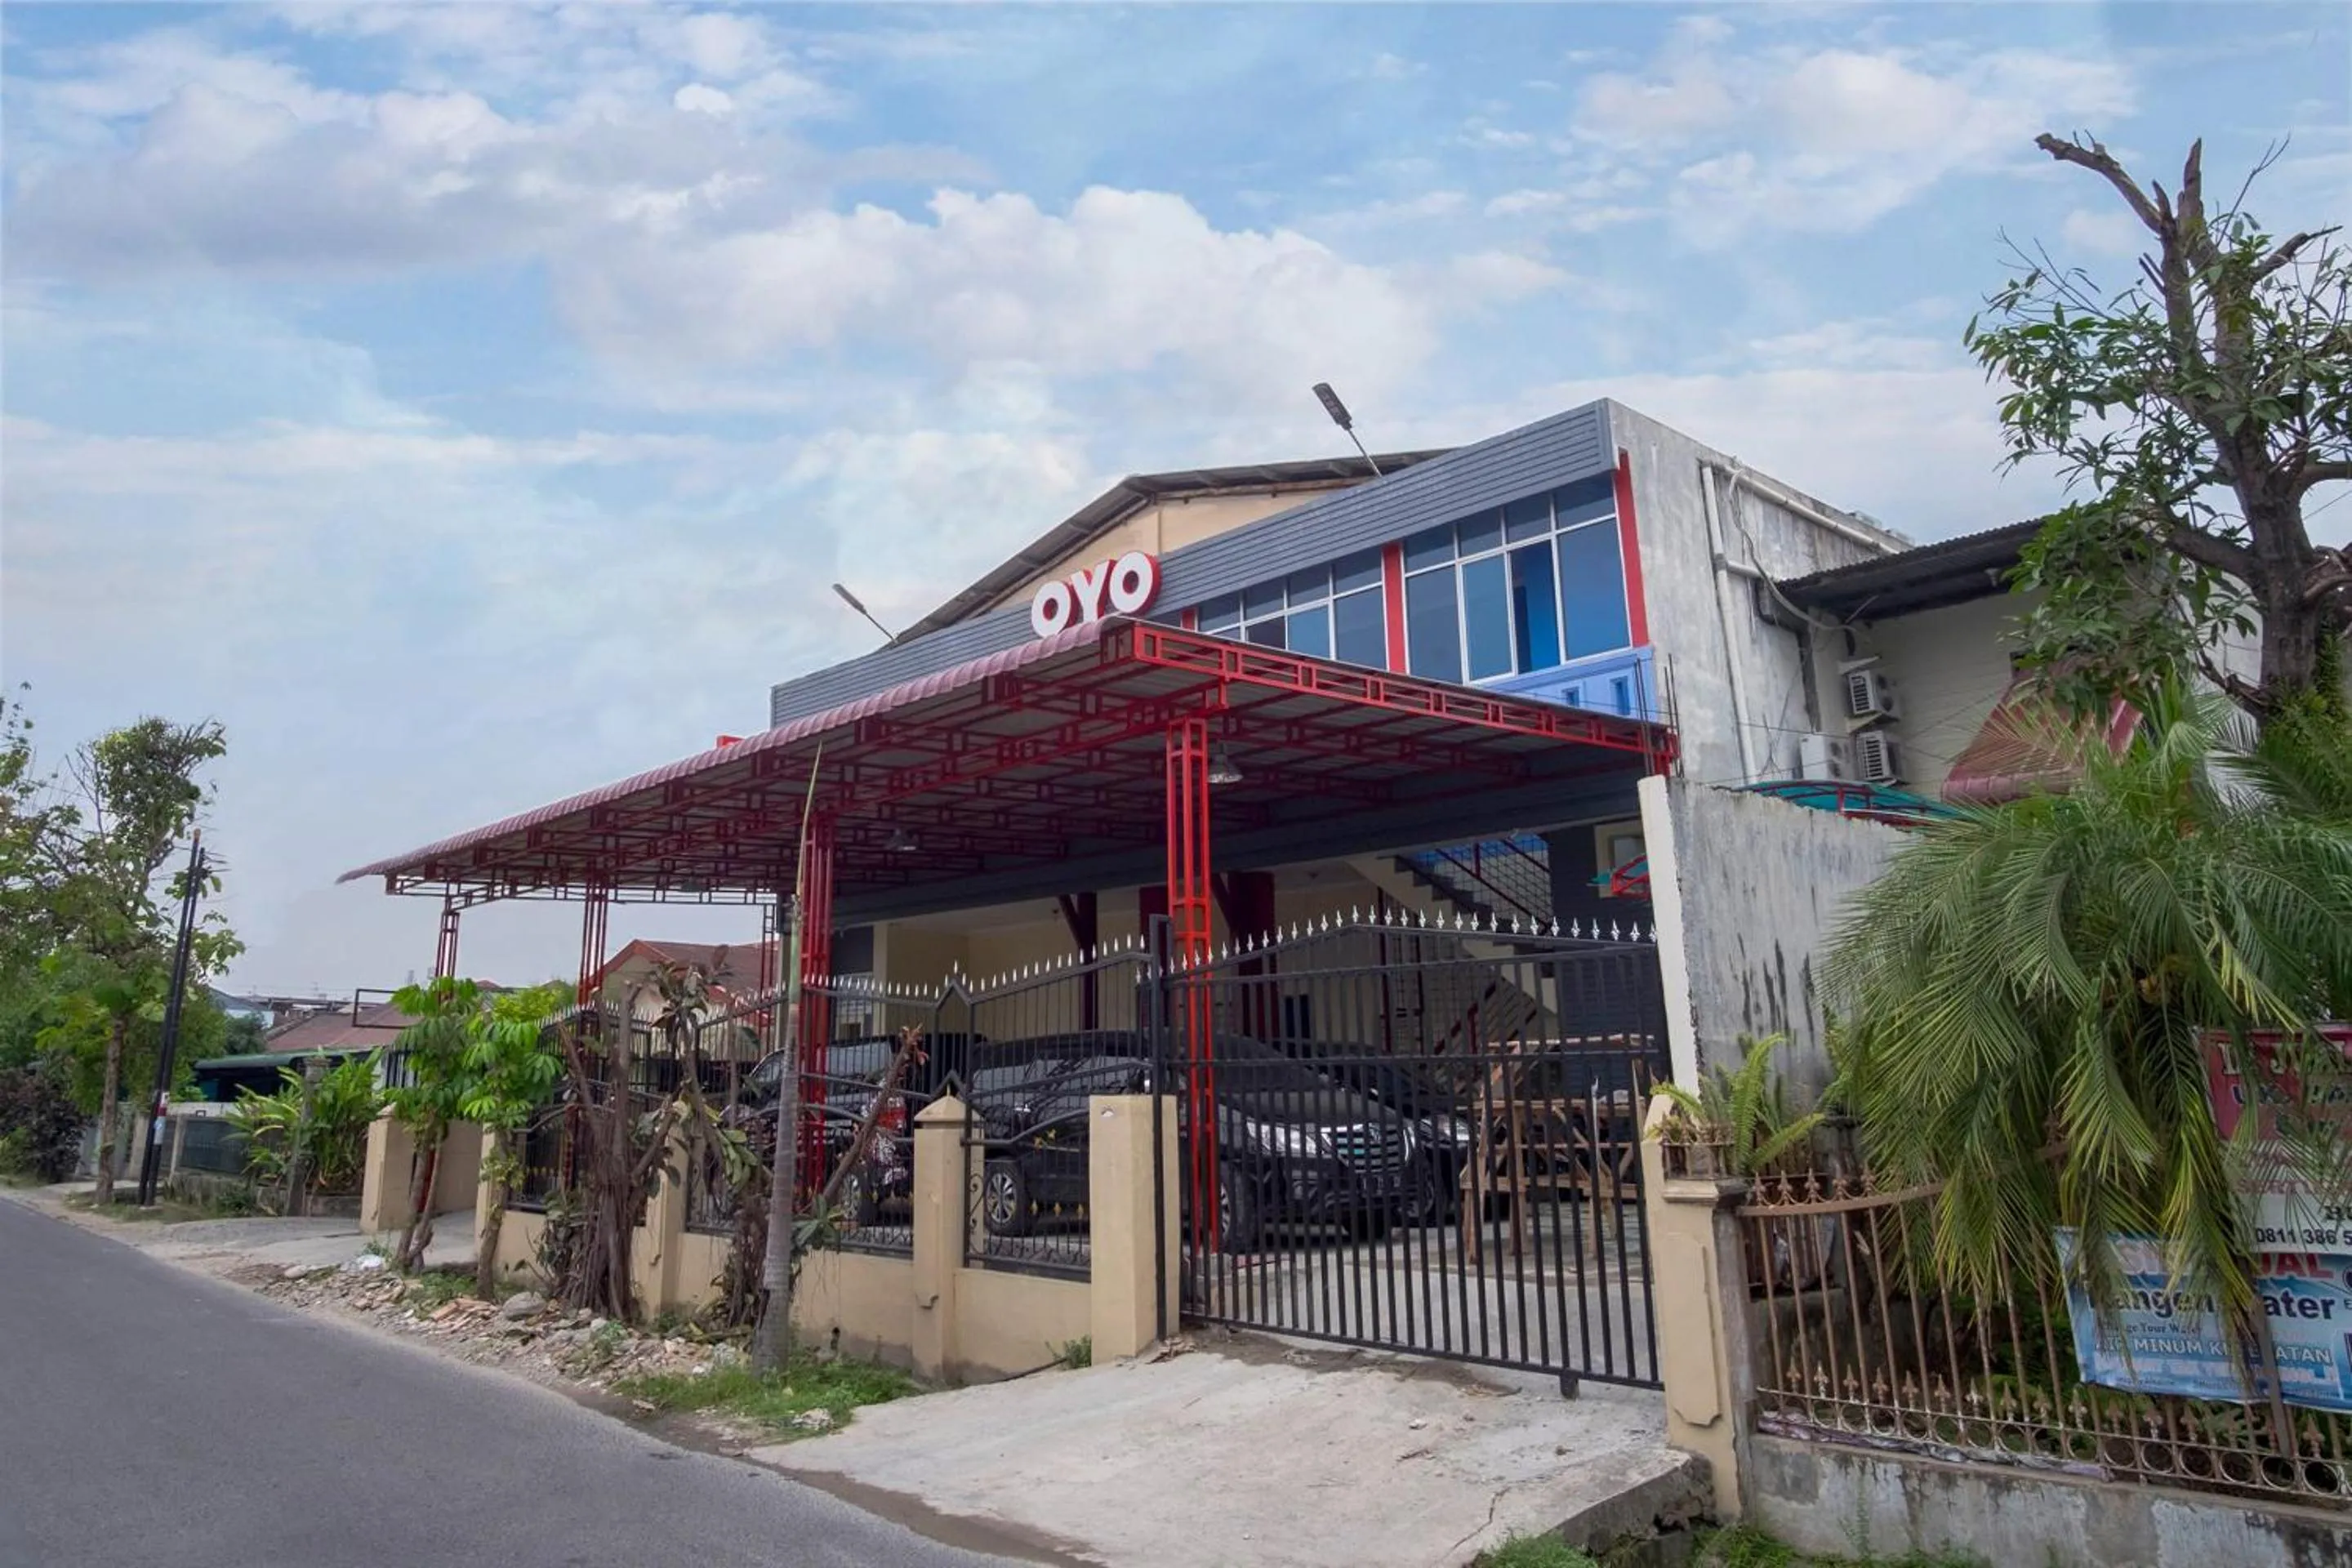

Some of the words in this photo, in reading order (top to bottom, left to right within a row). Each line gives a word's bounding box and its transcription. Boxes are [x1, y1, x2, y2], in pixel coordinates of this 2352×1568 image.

[1031, 551, 1160, 638] OYO
[2255, 1227, 2297, 1243] 0811
[2303, 1228, 2336, 1245] 386
[2263, 1290, 2335, 1319] ater
[2133, 1338, 2203, 1355] MINUM
